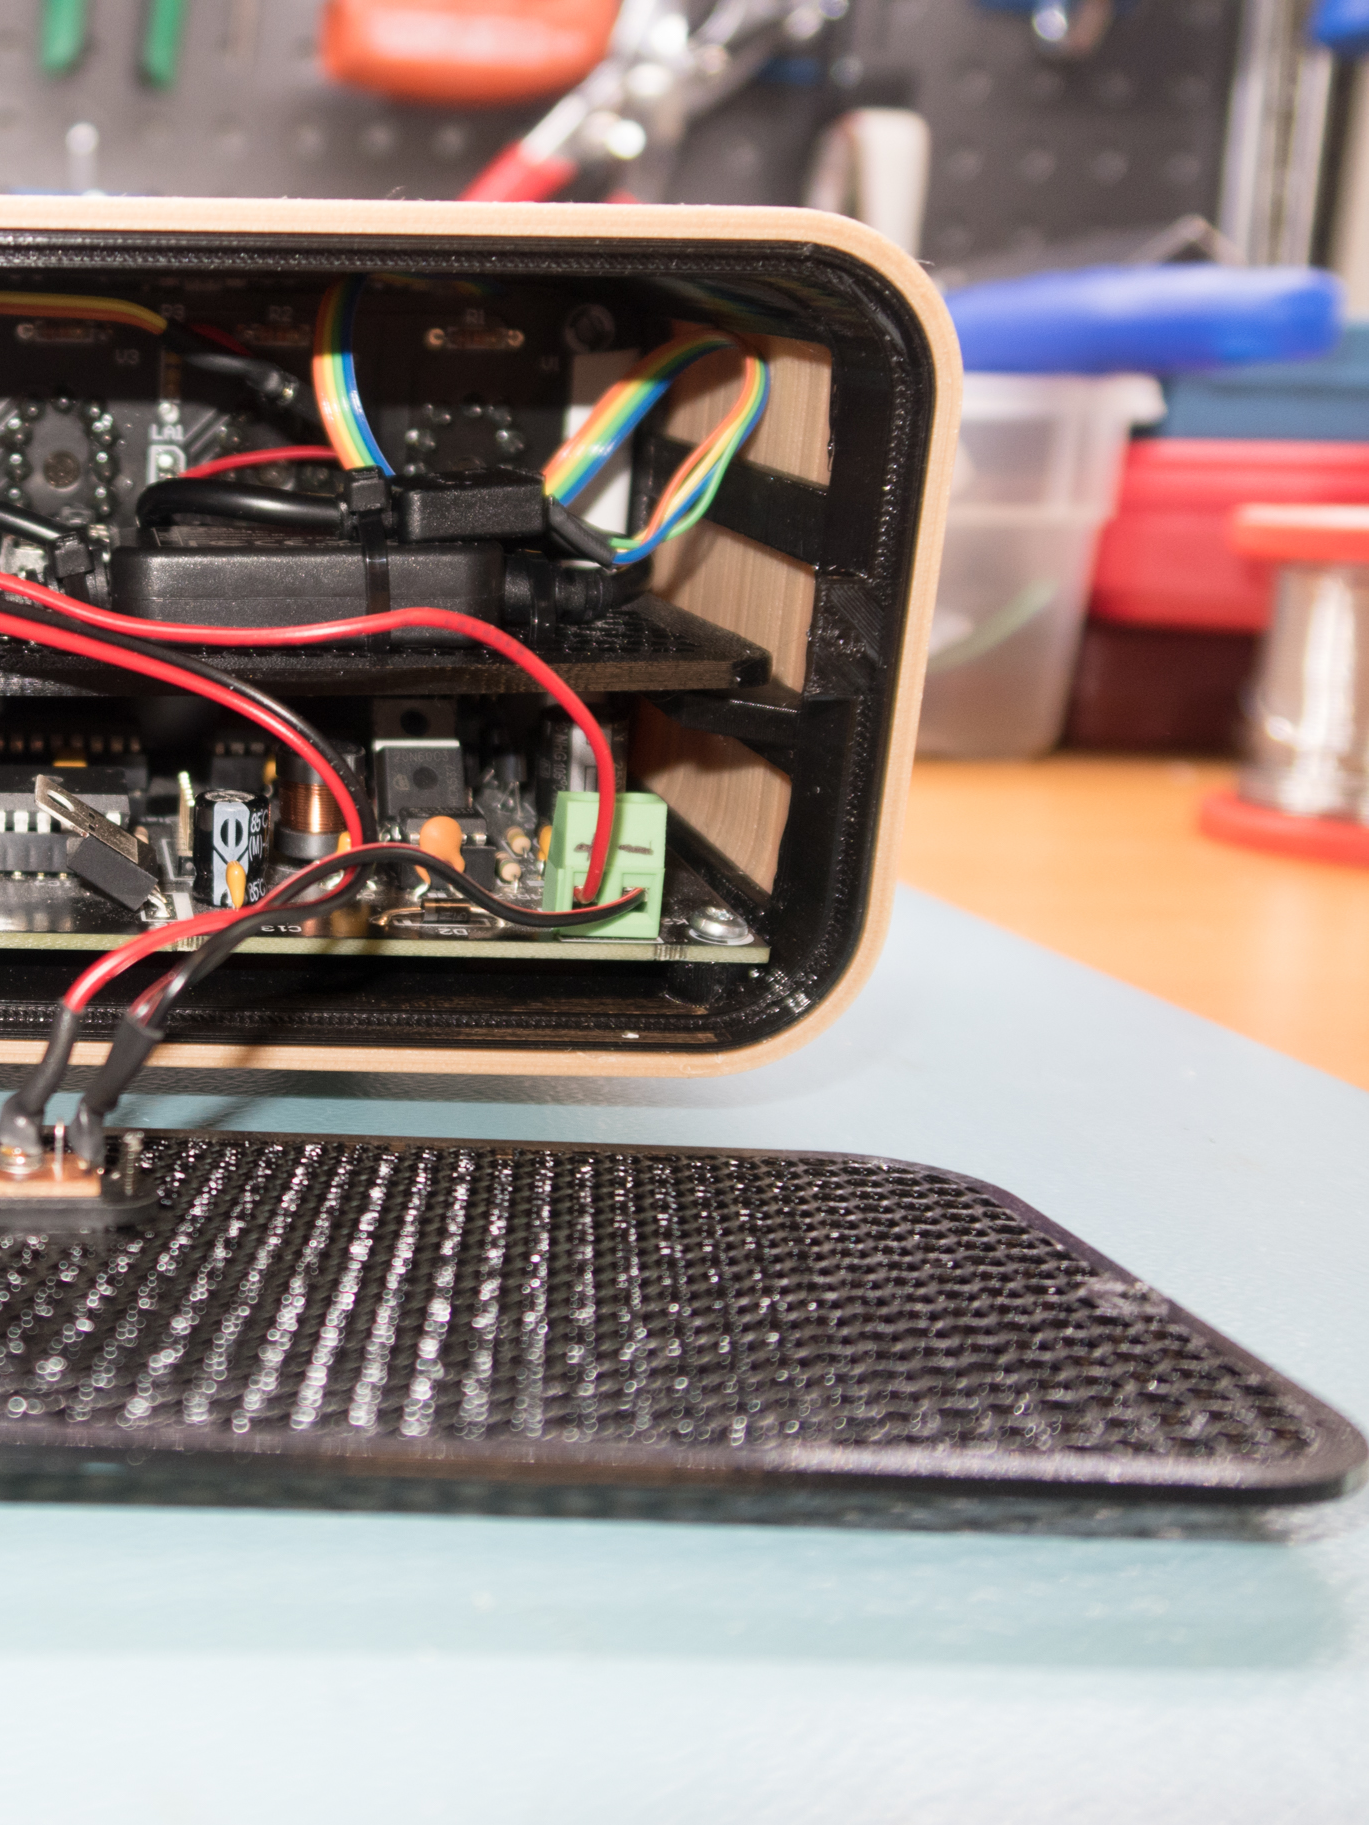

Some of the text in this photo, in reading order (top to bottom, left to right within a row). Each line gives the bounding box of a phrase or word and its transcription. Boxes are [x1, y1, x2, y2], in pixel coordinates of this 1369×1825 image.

[268, 305, 294, 322] R2
[115, 350, 140, 365] U3
[150, 424, 184, 441] LA1
[250, 808, 269, 833] 85°C
[247, 878, 267, 902] 85°C
[260, 924, 303, 934] C13
[438, 927, 469, 937] D2
